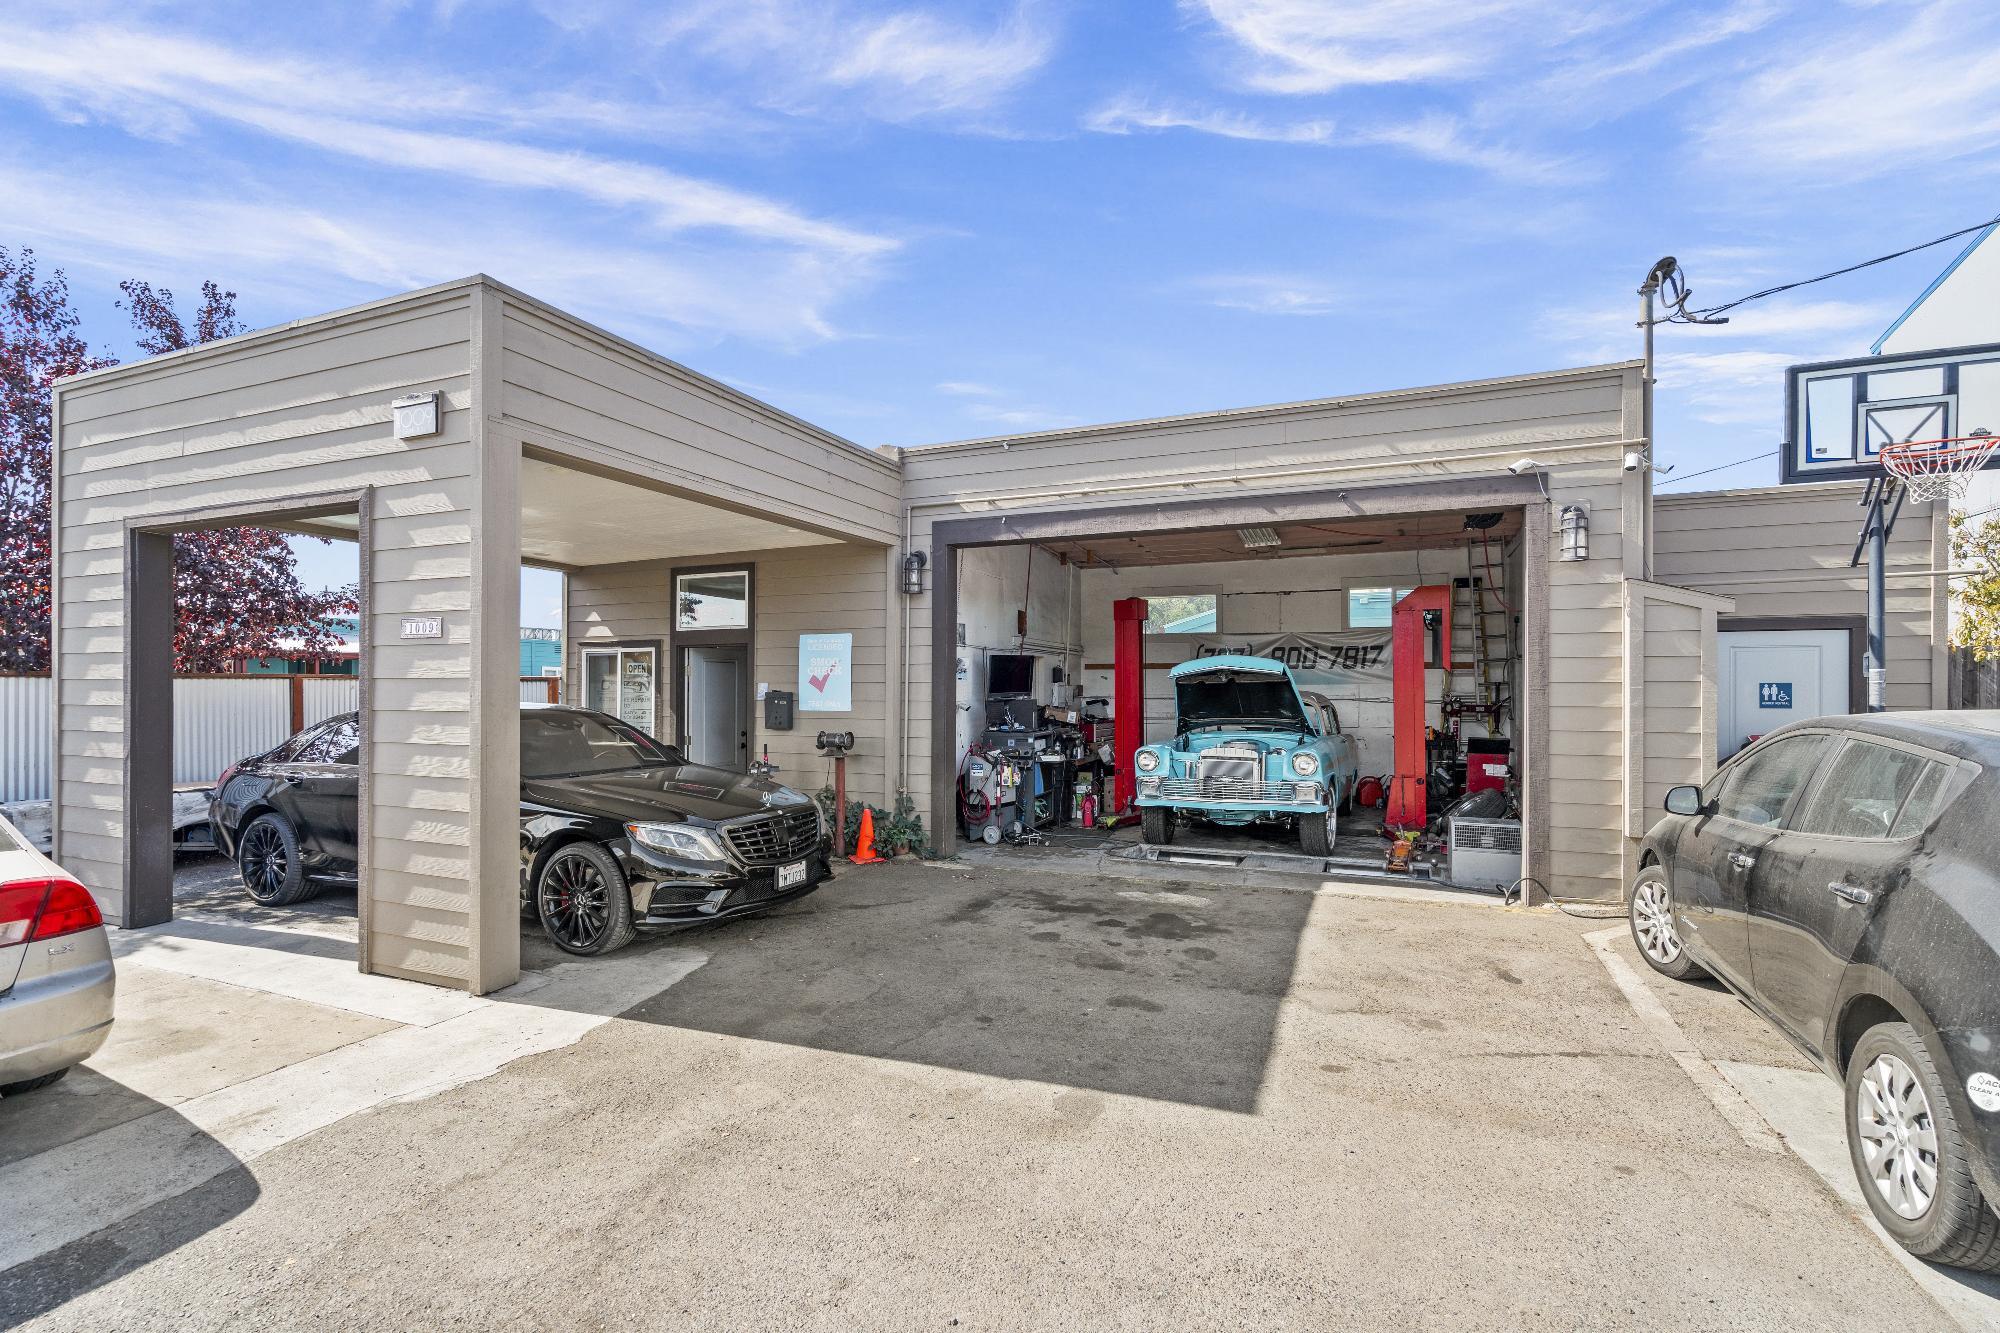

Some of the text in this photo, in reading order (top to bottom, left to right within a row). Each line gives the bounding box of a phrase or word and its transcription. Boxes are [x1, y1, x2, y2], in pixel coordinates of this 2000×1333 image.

[409, 622, 434, 634] 1009
[628, 664, 647, 674] OPEN
[1985, 1080, 2000, 1089] AC
[1970, 1085, 1993, 1095] CLEAN
